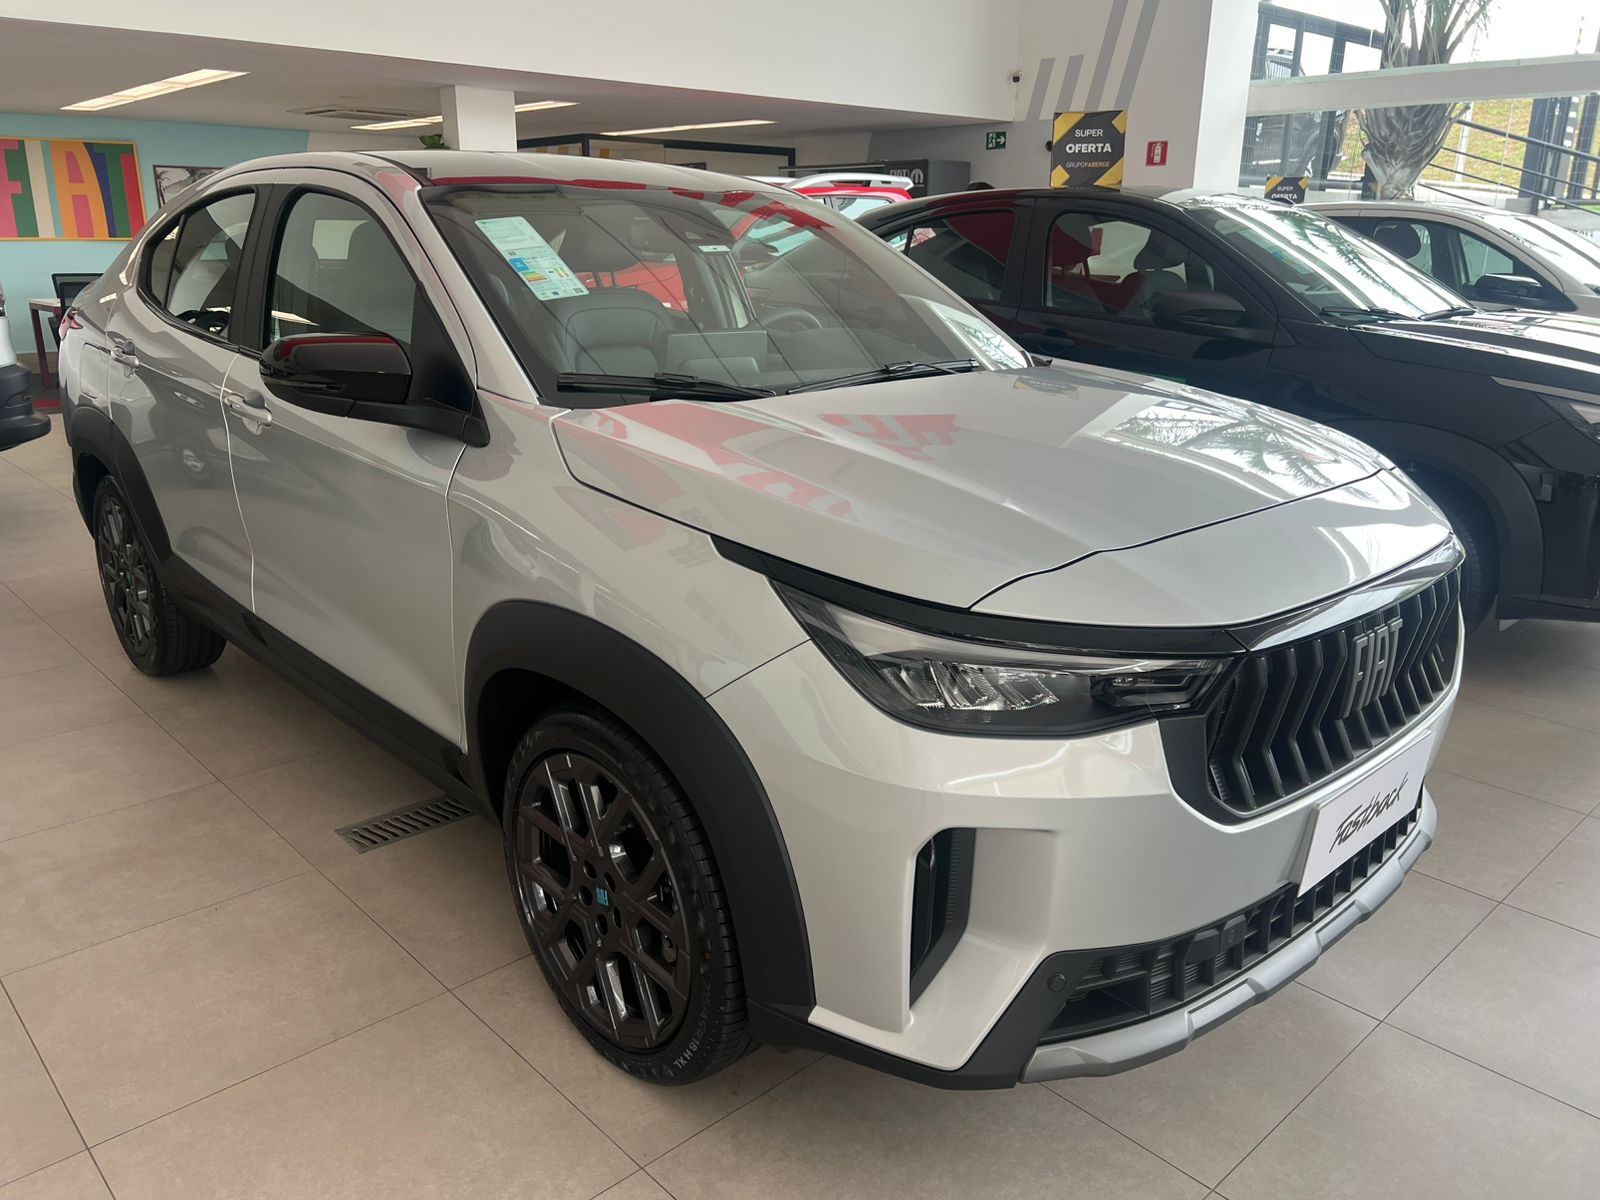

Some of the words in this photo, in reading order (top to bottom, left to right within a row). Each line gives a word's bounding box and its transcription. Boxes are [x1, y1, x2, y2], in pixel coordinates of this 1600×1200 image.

[1066, 143, 1111, 153] OFERTA
[1075, 129, 1103, 137] SUPER
[0, 139, 134, 238] FIAT
[1343, 618, 1404, 719] FIAT
[1329, 772, 1409, 854] Fastback
